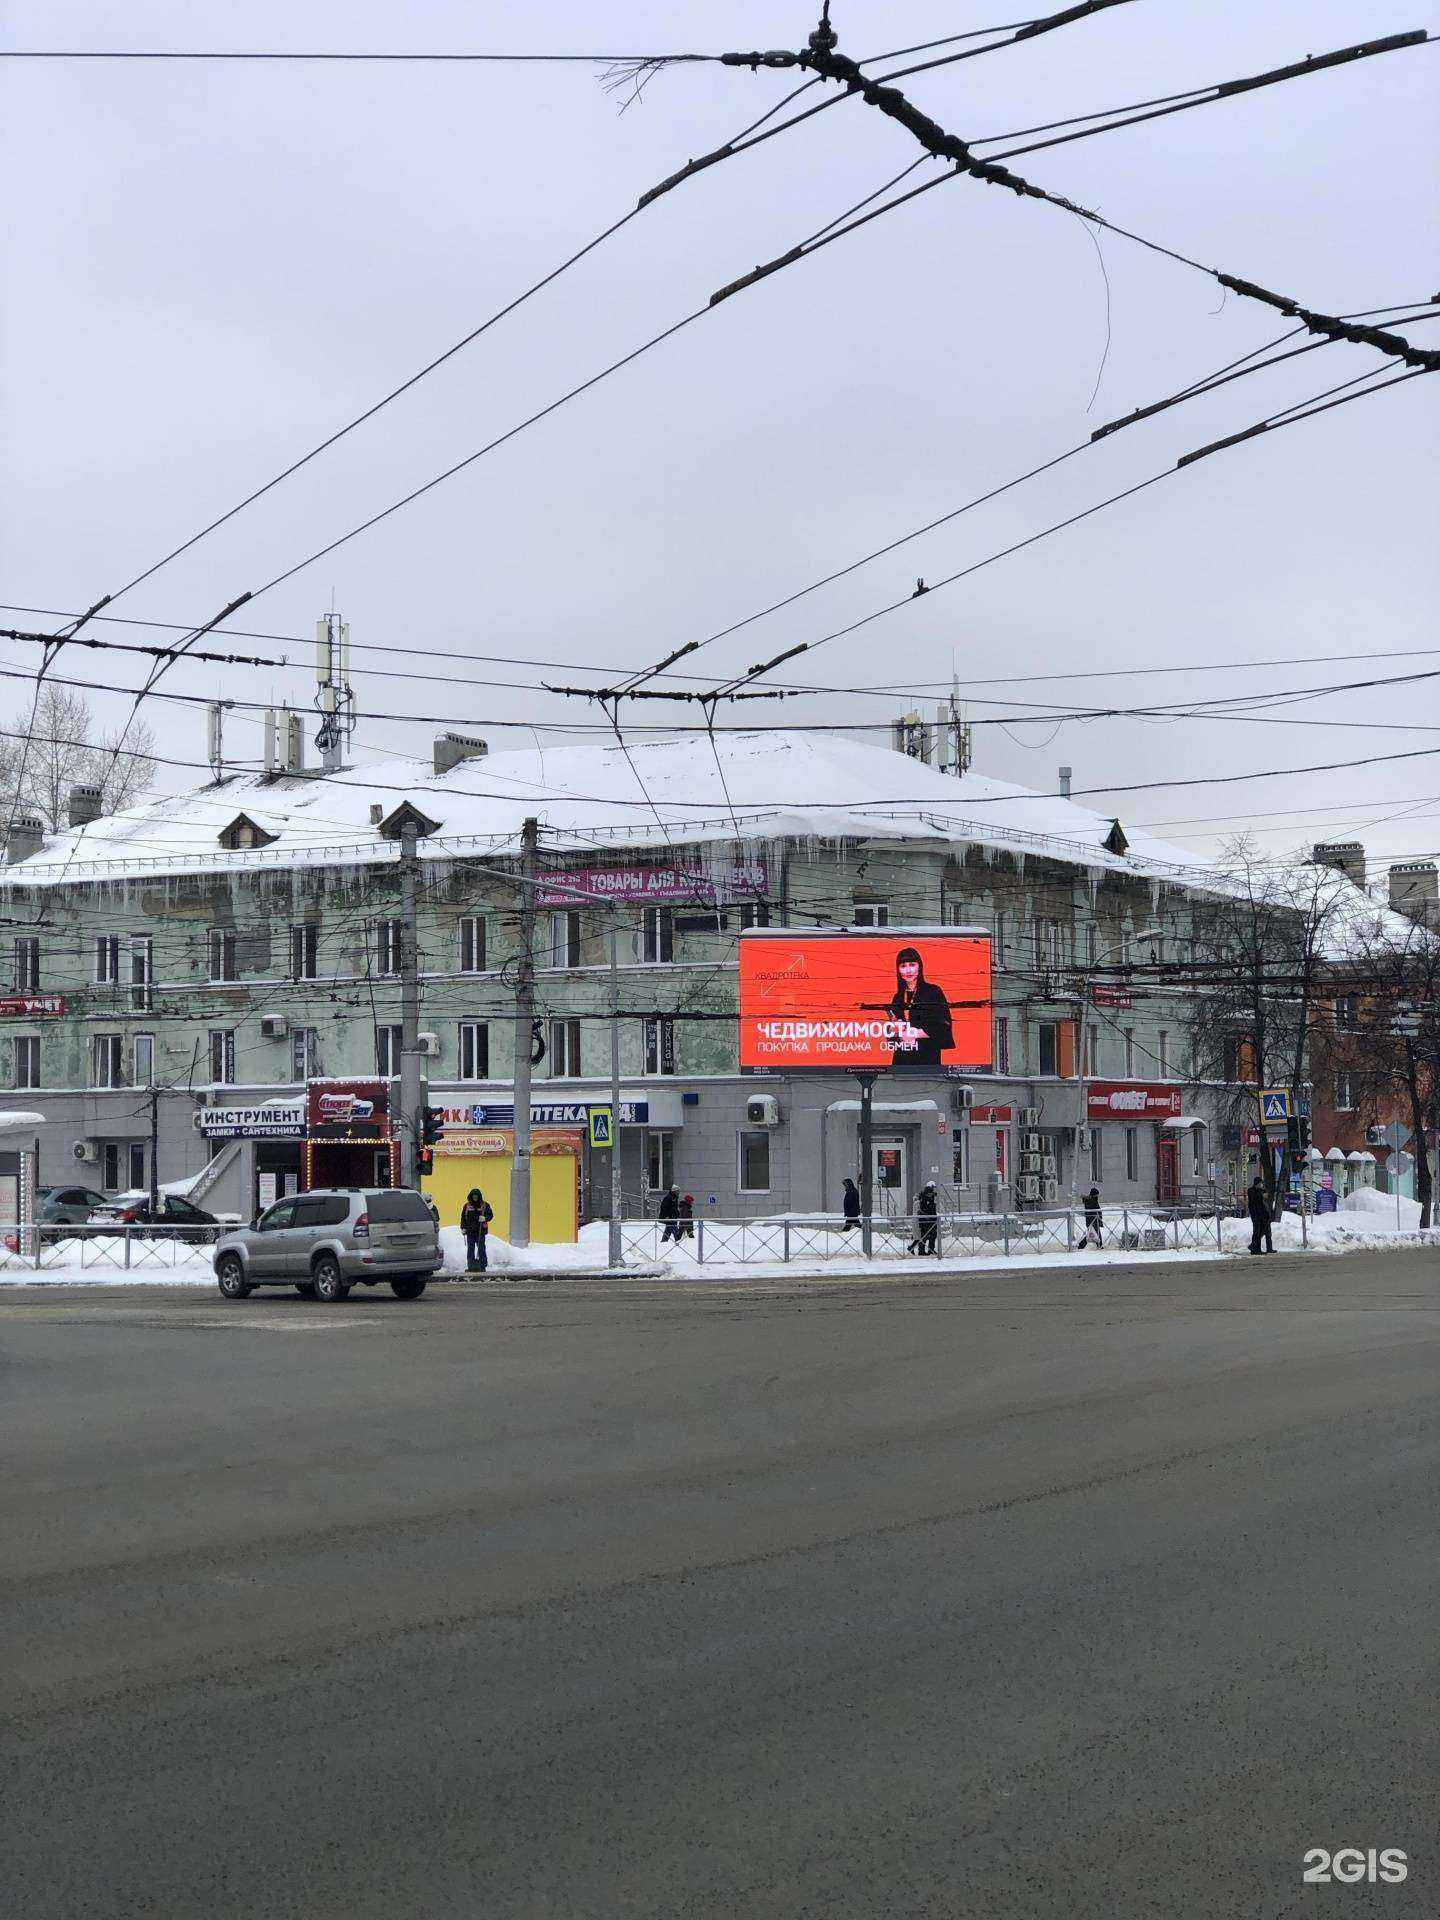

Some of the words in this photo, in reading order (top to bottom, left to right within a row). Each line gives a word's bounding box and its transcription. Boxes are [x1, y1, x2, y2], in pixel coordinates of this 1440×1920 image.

[590, 872, 643, 891] ТОВАРЫ
[755, 971, 810, 981] КВАДРОТЕКА
[757, 1041, 809, 1052] ПОКУПКА
[816, 1041, 872, 1053] ПРОДАЖА
[879, 1041, 919, 1051] ОБМЕН
[205, 1110, 300, 1124] ИНСТРУМЕНТ
[530, 1106, 588, 1121] ПТЕКА
[206, 1128, 235, 1137] ЗАМКИ
[242, 1126, 301, 1136] САНТЕХНИКА
